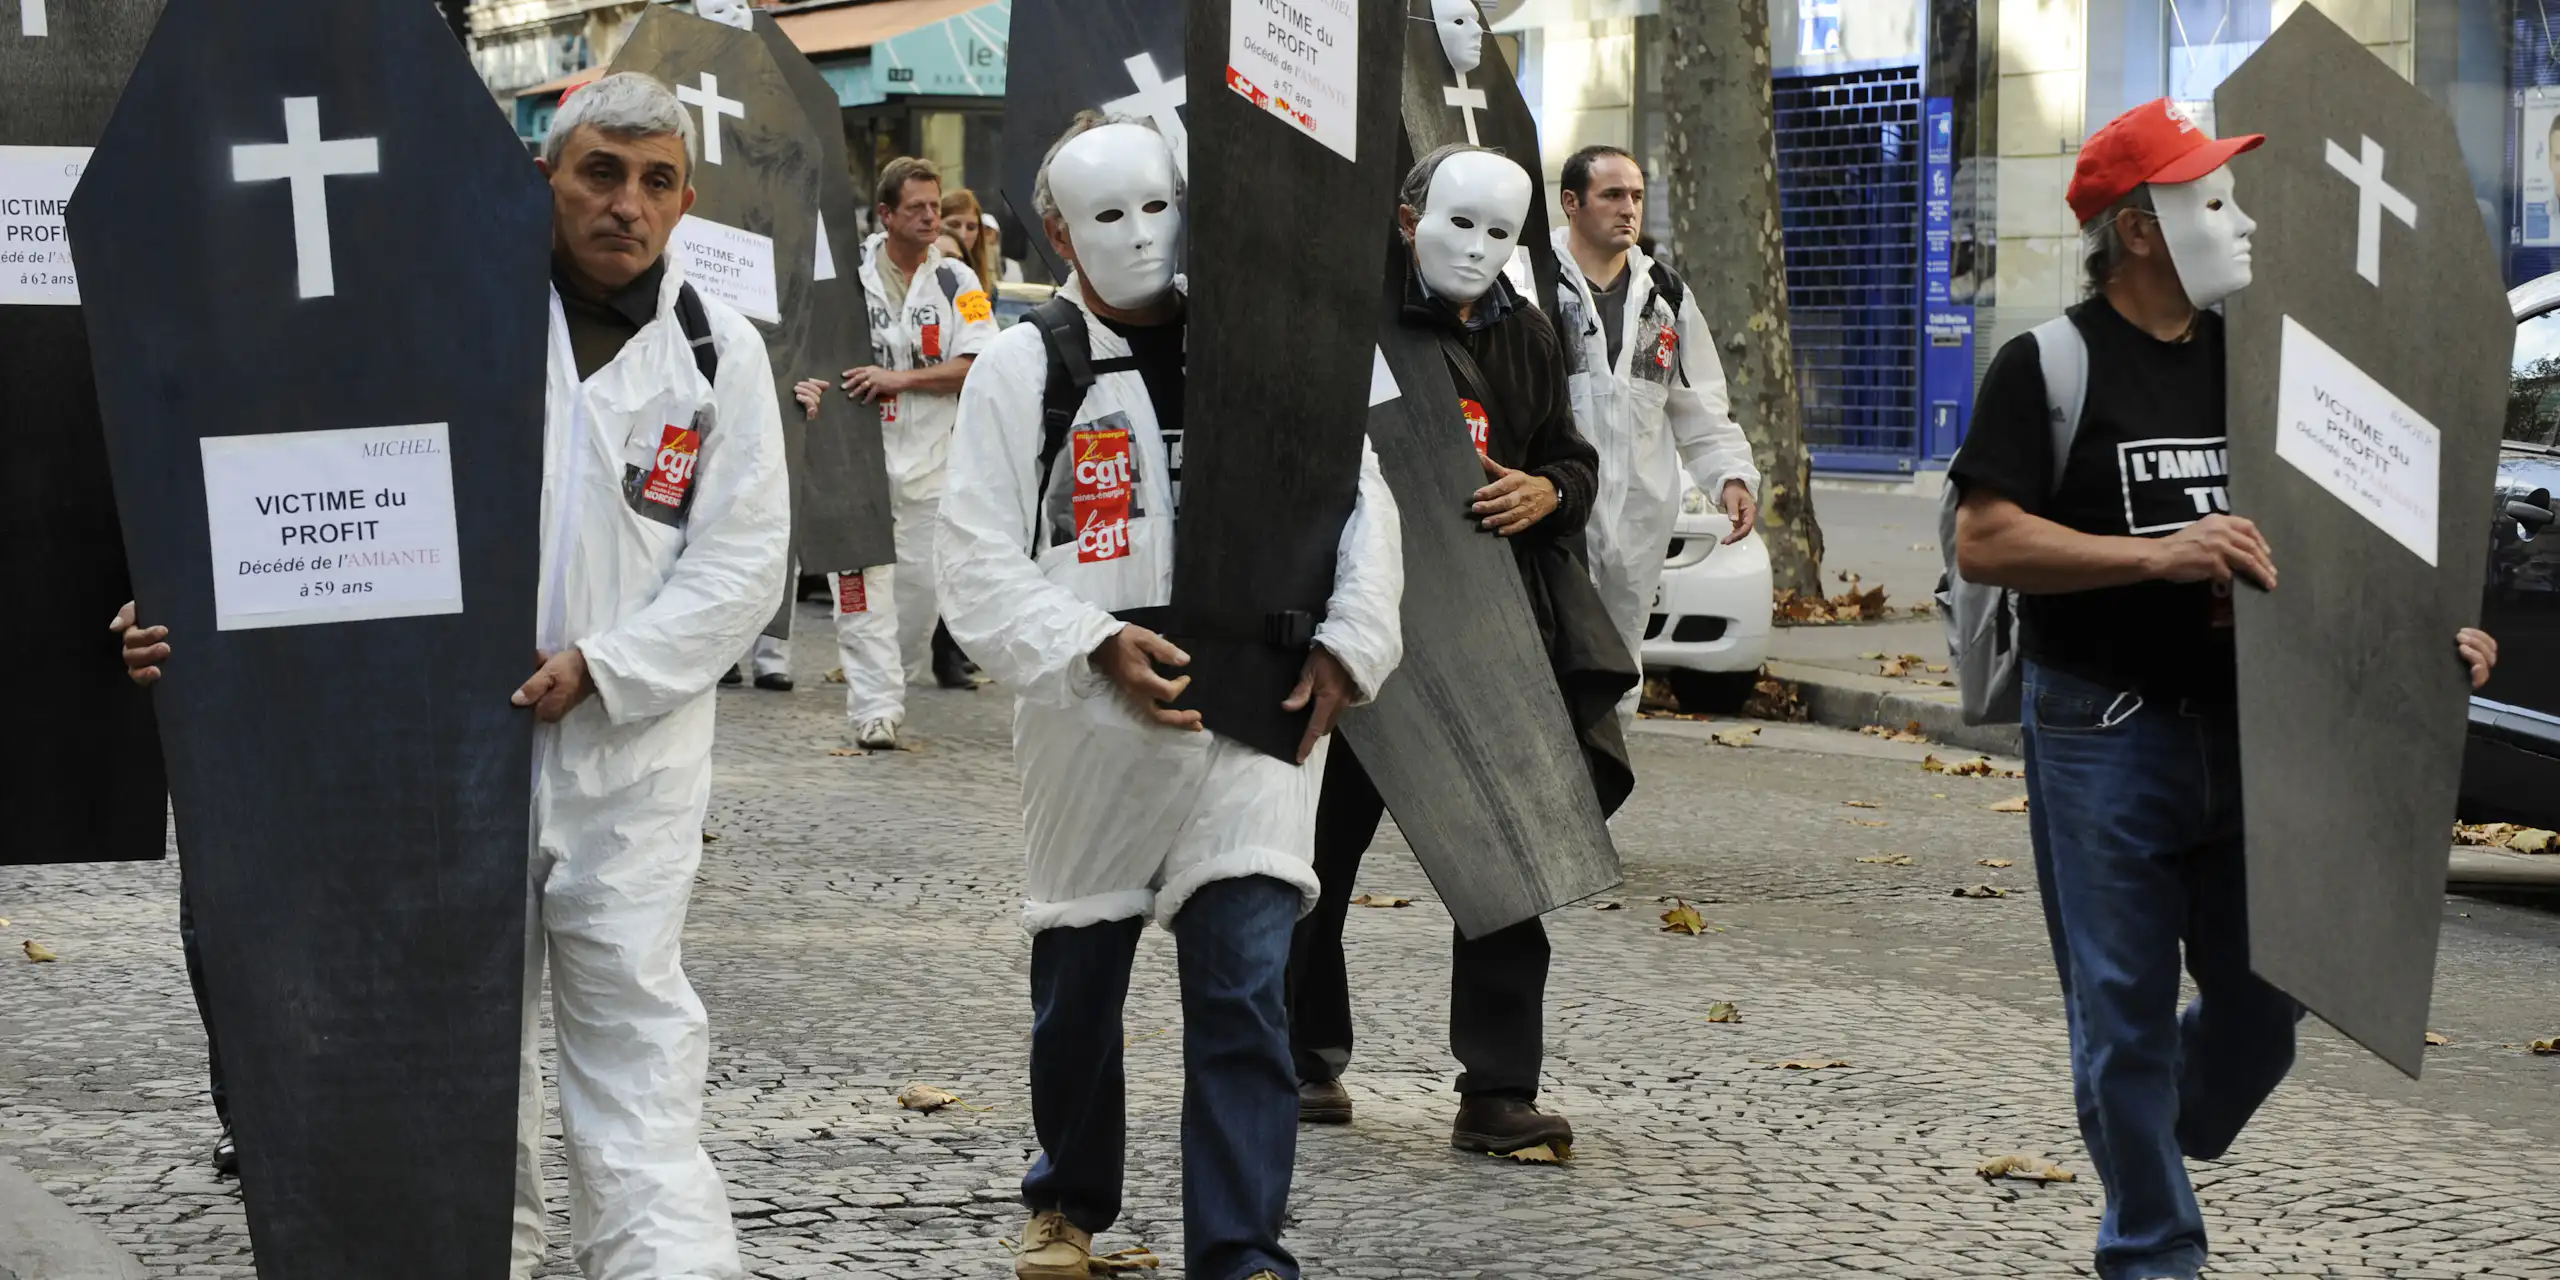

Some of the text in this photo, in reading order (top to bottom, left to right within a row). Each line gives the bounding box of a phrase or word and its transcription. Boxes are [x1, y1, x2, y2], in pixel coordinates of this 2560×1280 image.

[1268, 22, 1318, 65] PROFIT
[1317, 26, 1333, 47] du
[968, 38, 992, 66] le
[1244, 36, 1279, 65] Décédé
[1281, 58, 1292, 74] de
[1282, 82, 1293, 96] 57
[1295, 93, 1312, 108] ans
[28, 251, 45, 263] de
[684, 240, 754, 268] VICTIME du
[31, 272, 47, 285] 62
[51, 274, 74, 285] ans
[695, 258, 741, 278] PROFIT
[2313, 385, 2410, 467] VICTIME du
[362, 438, 441, 458] MICHEL,
[2327, 419, 2389, 473] PROFIT
[657, 448, 698, 484] cgt
[1076, 451, 1131, 490] cgt
[2343, 455, 2357, 473] de
[255, 488, 407, 516] VICTIME du
[281, 520, 379, 546] PROFIT
[1078, 518, 1127, 558] cgt
[239, 548, 441, 575] Décédé de l'AMIANTE
[299, 579, 373, 597] à 59 ans
